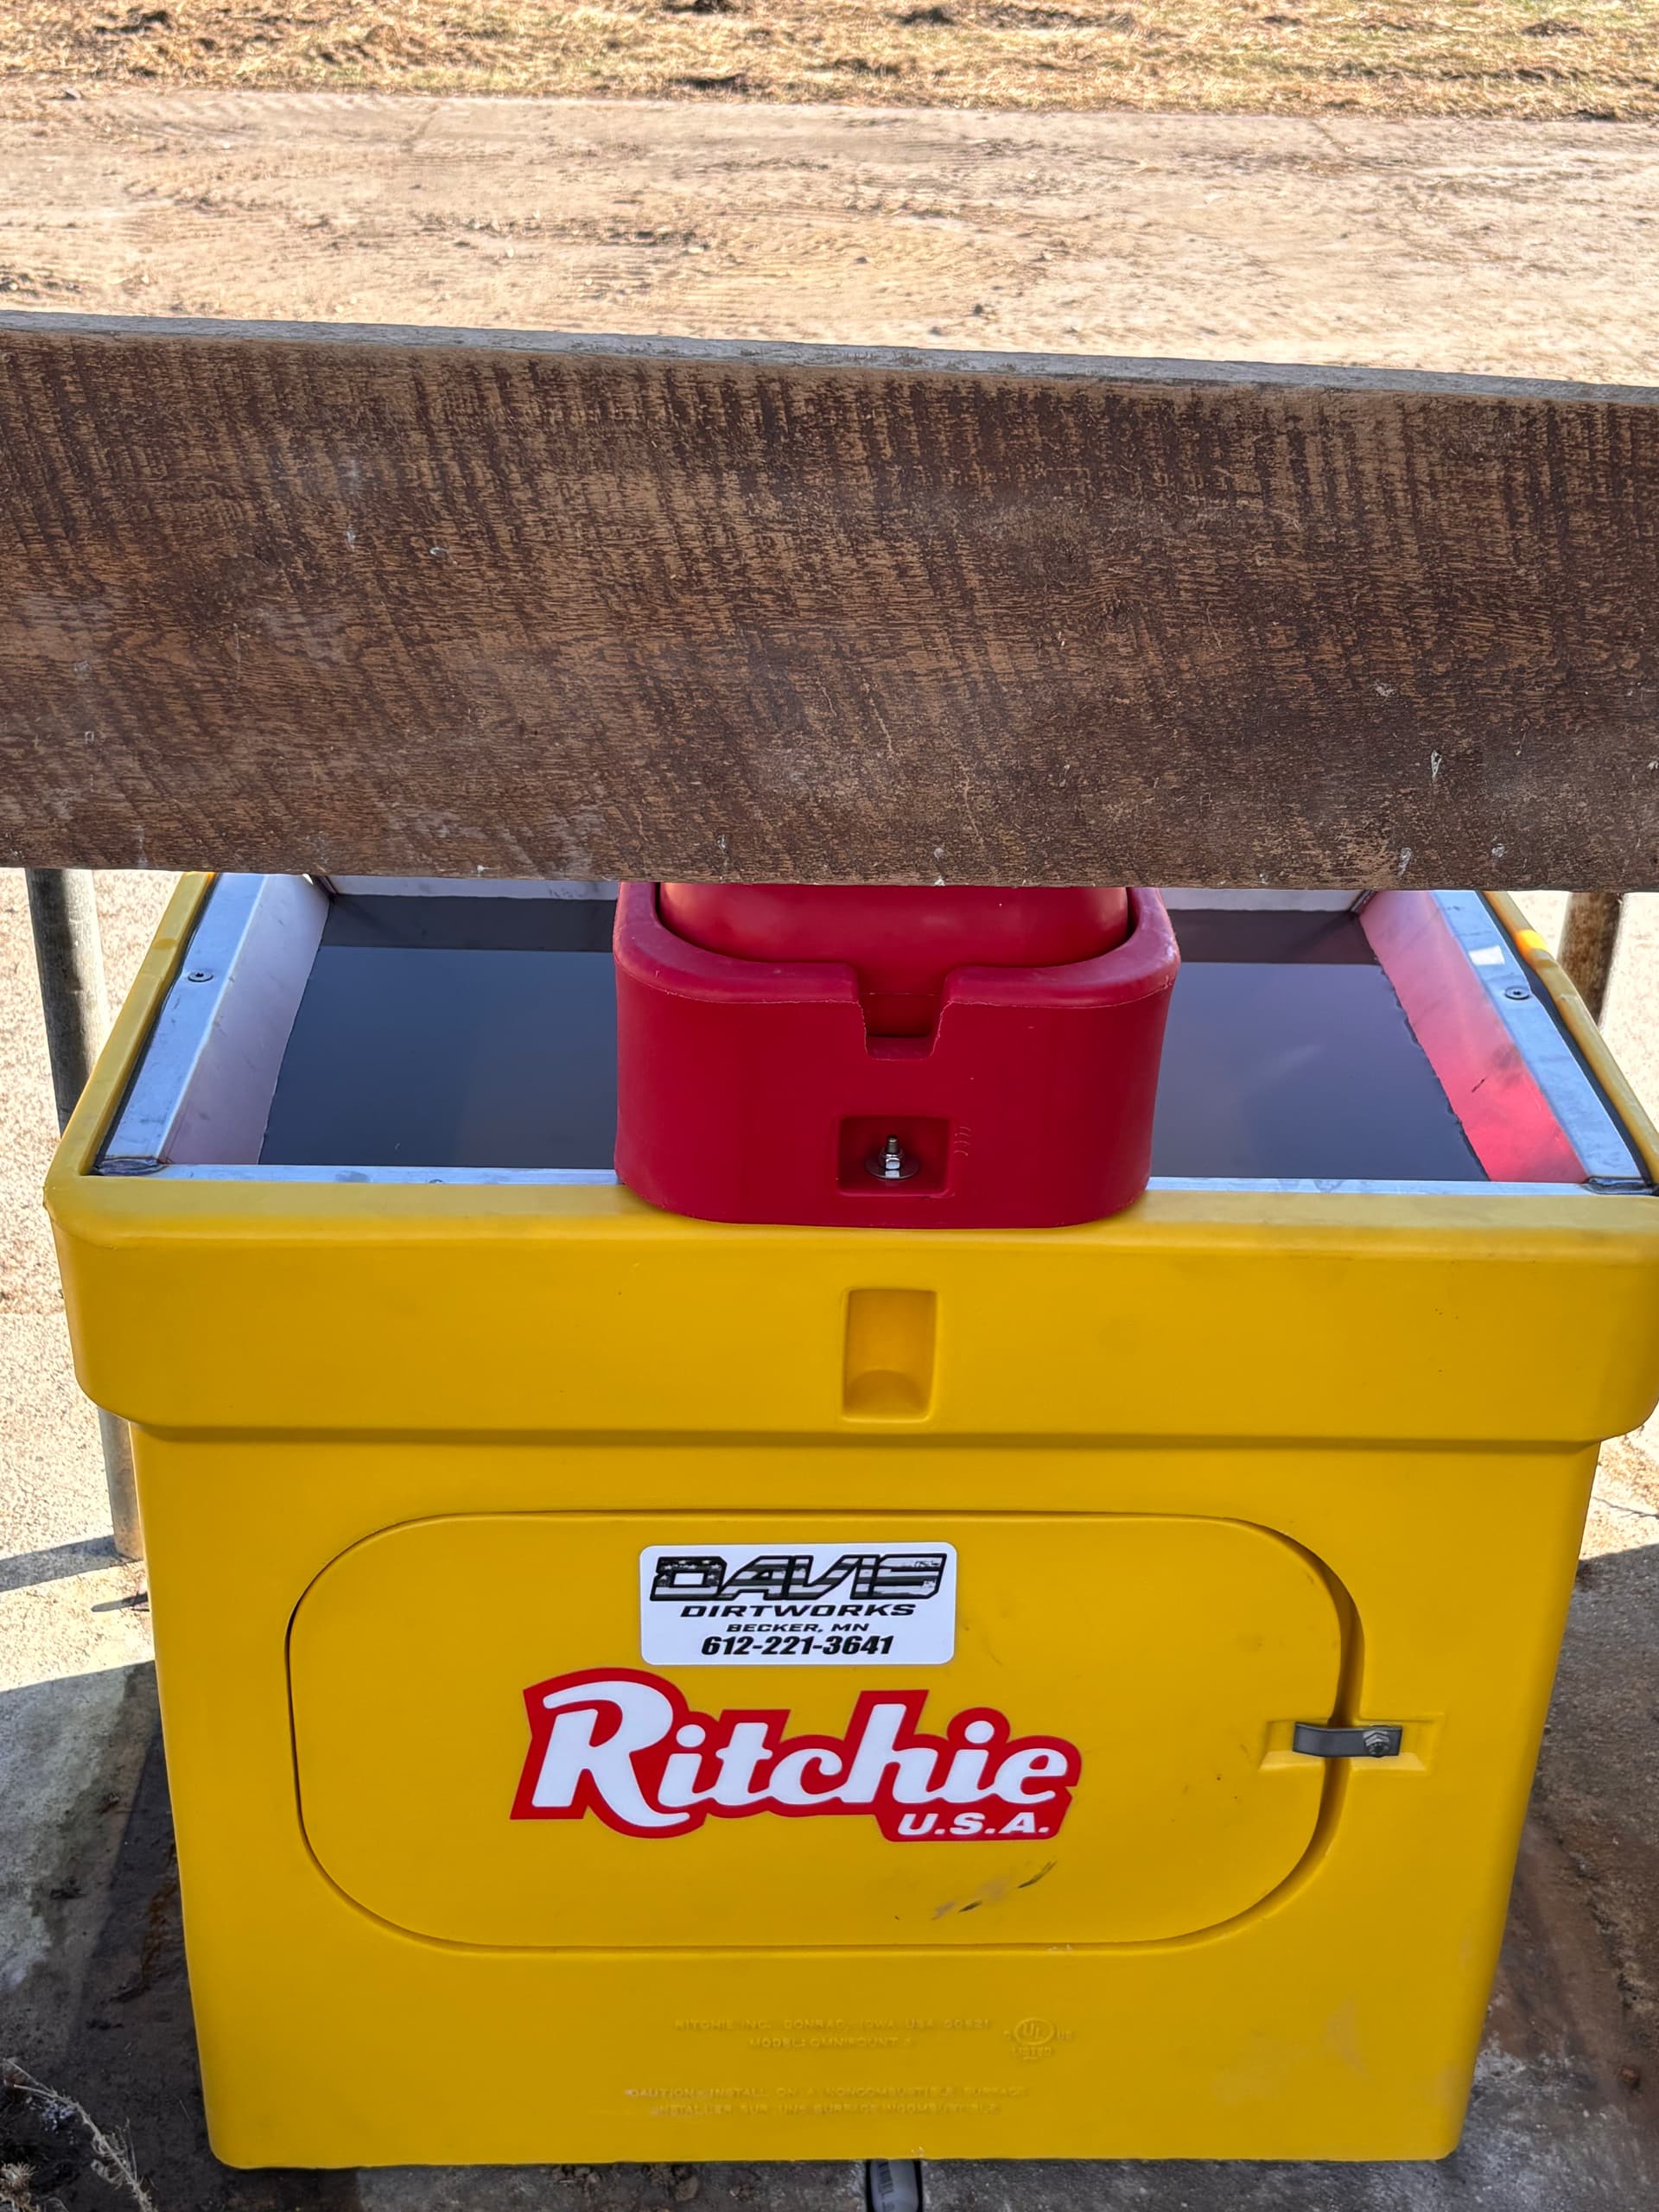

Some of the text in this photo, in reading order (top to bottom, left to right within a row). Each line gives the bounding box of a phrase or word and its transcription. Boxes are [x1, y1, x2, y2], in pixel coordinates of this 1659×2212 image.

[649, 1553, 948, 1601] DAVIS
[680, 1604, 916, 1618] DIRTWORKS
[726, 1622, 869, 1633] BECKER, MN
[701, 1635, 894, 1656] 612-221-3641
[531, 1681, 1068, 1827] Ritchie
[897, 1811, 1050, 1836] U.S.A.
